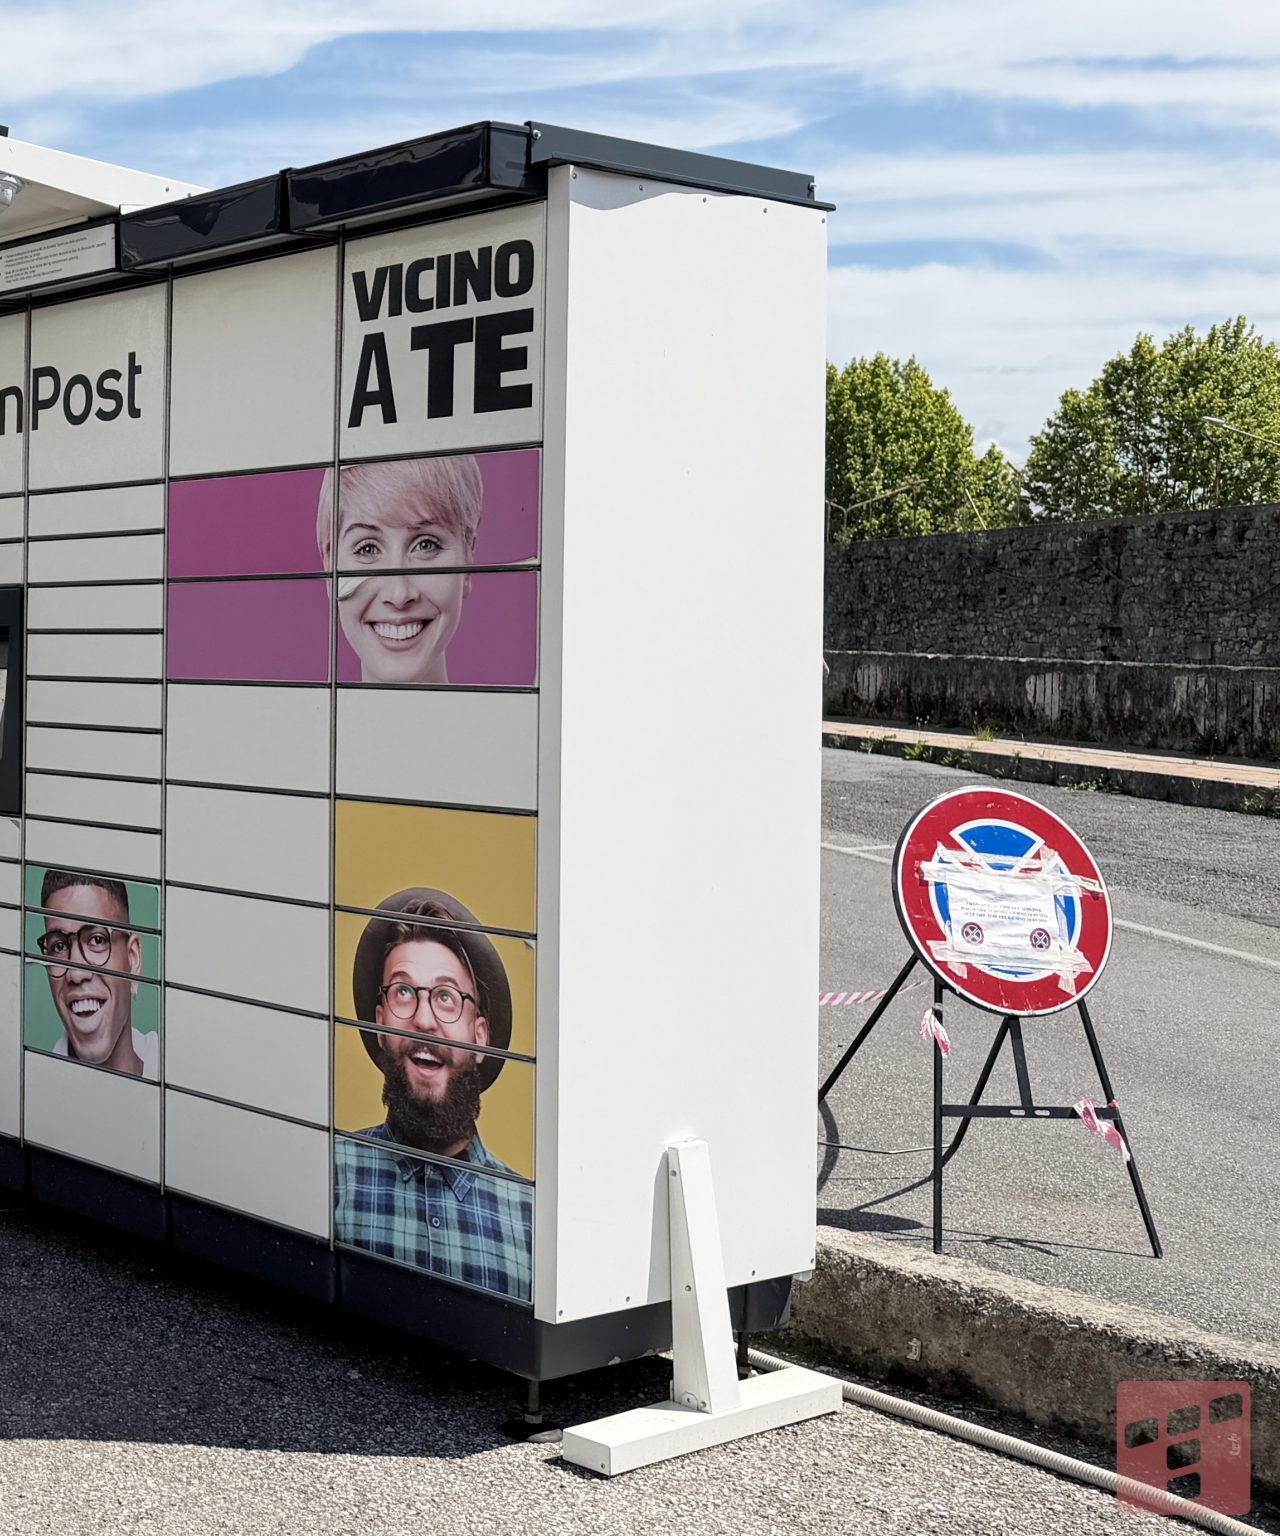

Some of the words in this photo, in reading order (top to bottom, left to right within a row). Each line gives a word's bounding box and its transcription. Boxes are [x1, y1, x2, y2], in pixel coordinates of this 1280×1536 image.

[352, 239, 535, 322] VICINO
[348, 331, 397, 428] A
[410, 307, 534, 419] TE
